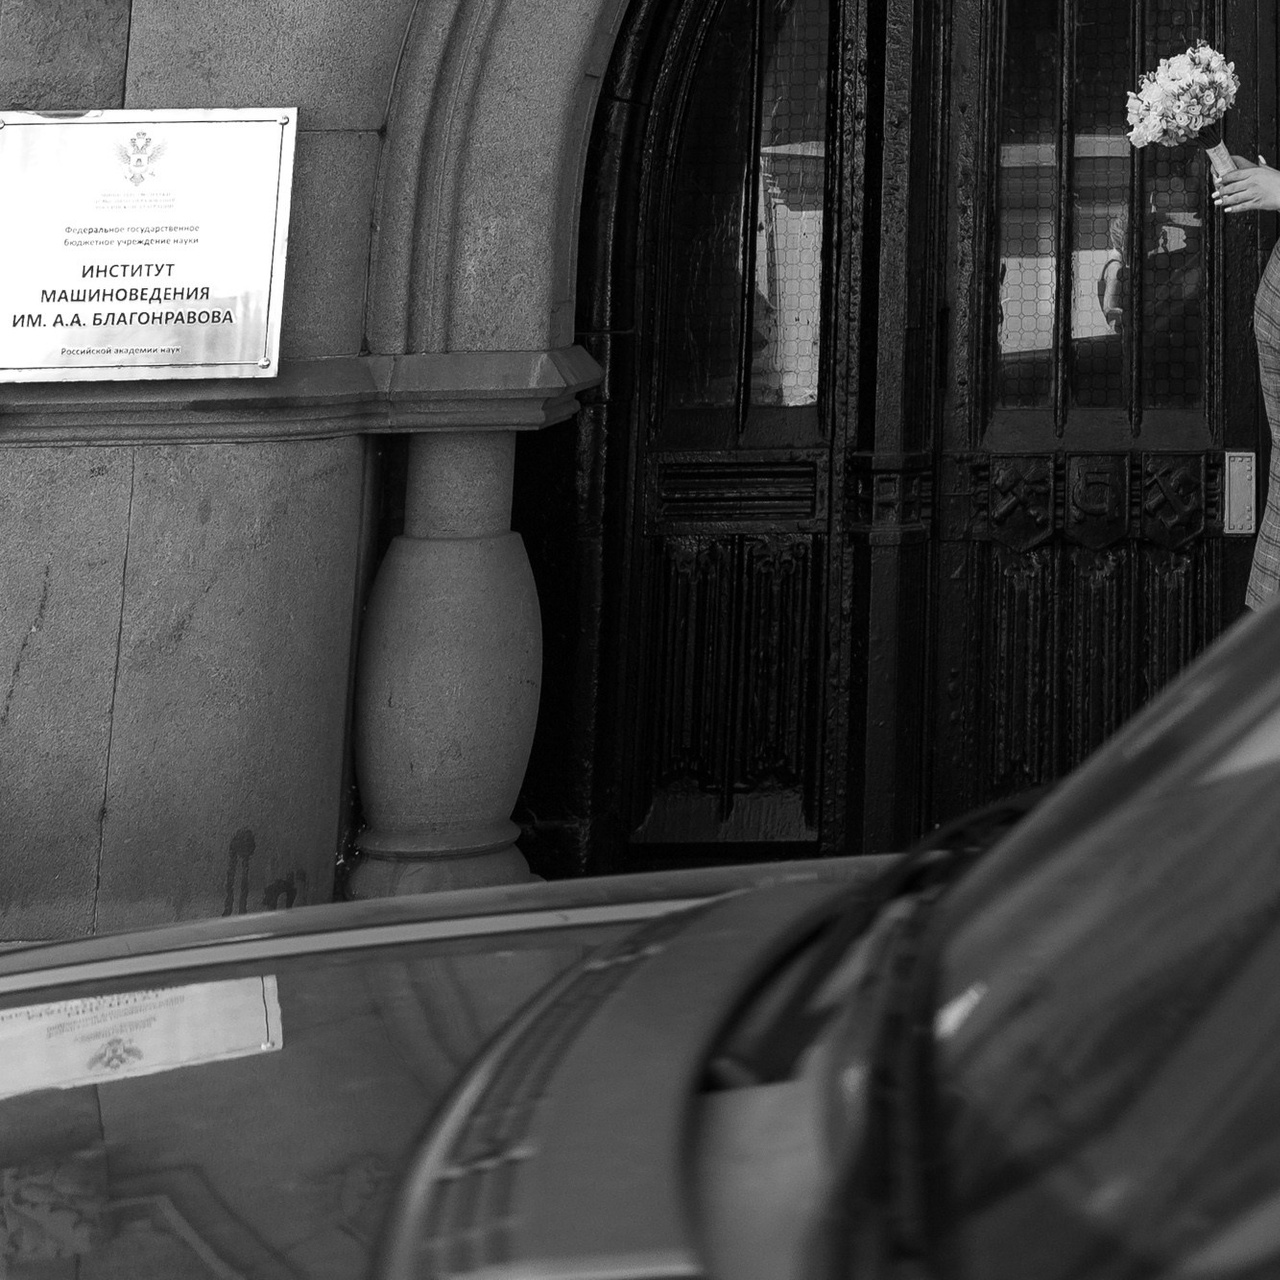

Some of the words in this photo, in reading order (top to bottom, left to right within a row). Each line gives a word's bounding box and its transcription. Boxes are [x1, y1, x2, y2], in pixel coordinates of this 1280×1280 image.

[64, 225, 125, 236] Федеральное
[127, 225, 200, 235] государственное
[63, 238, 115, 247] бюджетное
[117, 238, 171, 247] учреждение
[173, 237, 200, 246] науки
[81, 263, 176, 279] ИНСТИТУТ
[40, 286, 211, 304] МАШИНОВЕДЕНИЯ
[12, 313, 47, 328] ИМ.
[52, 312, 86, 327] А.А.
[92, 310, 234, 327] БЛАГОНРАВОВА
[60, 347, 112, 355] Российской
[113, 347, 158, 355] академии
[160, 346, 181, 355] наук
